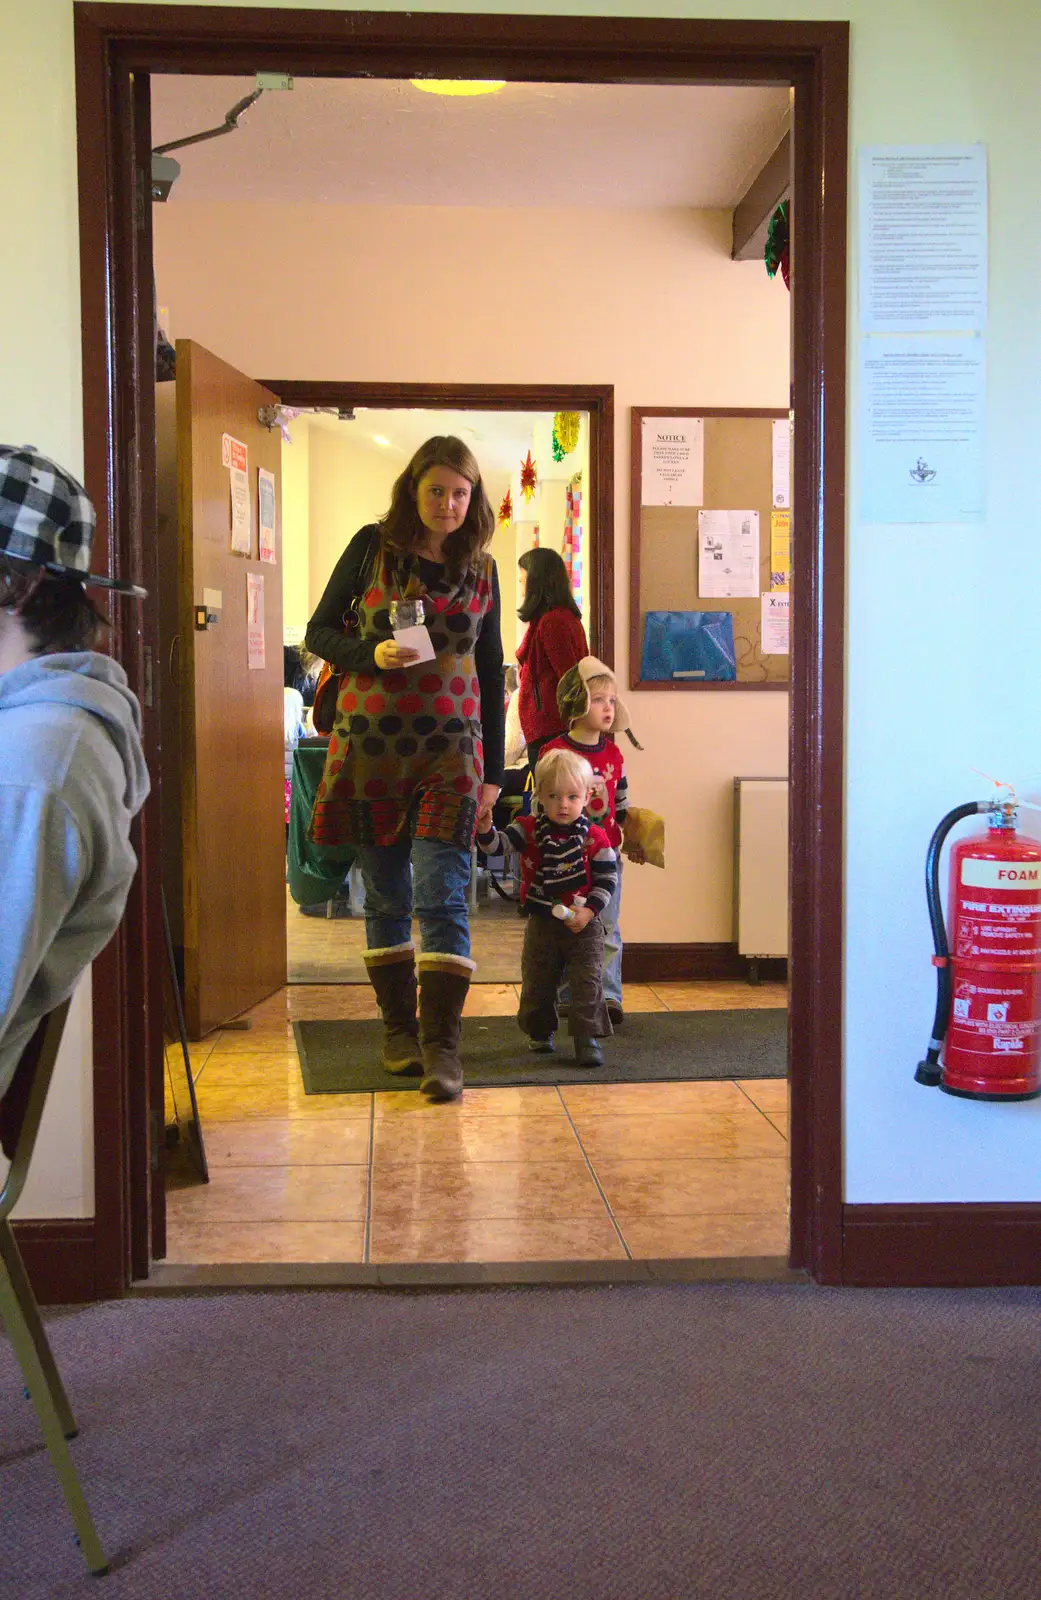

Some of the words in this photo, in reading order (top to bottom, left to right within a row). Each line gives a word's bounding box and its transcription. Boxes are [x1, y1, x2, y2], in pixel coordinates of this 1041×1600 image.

[656, 434, 687, 442] NOTICE
[998, 869, 1038, 881] FOAM
[962, 902, 987, 912] FIRE
